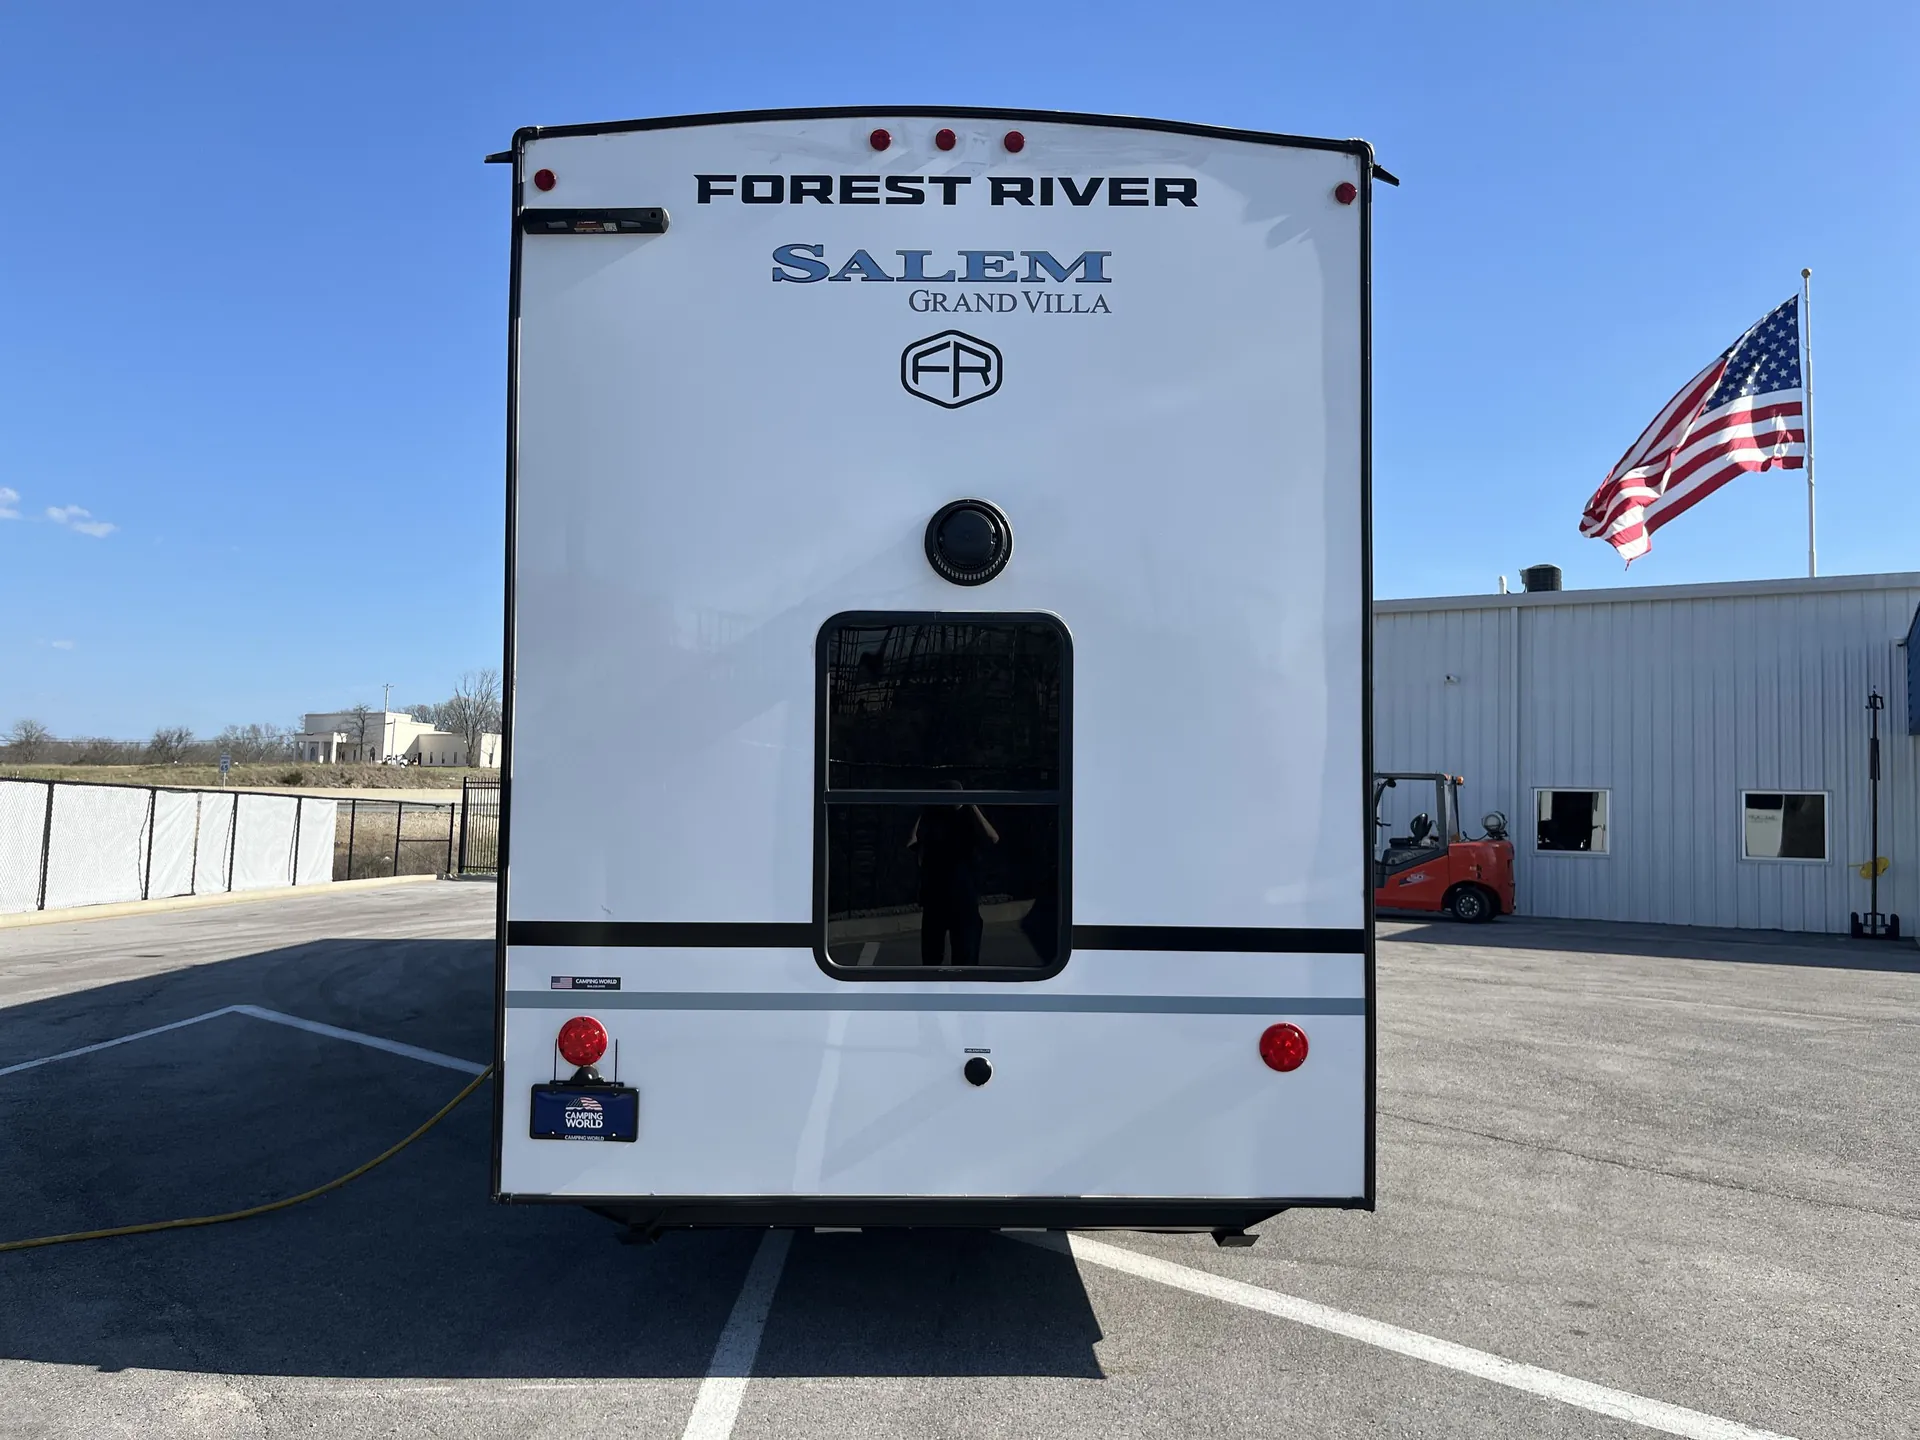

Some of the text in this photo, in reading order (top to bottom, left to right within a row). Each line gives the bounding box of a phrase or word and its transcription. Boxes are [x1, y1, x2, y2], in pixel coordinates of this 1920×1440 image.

[693, 174, 1199, 207] FOREST RIVER
[772, 243, 1112, 284] SALEM
[908, 289, 1112, 315] GRAND VILLA
[565, 1111, 603, 1120] CAMPING
[565, 1118, 603, 1128] WORLD
